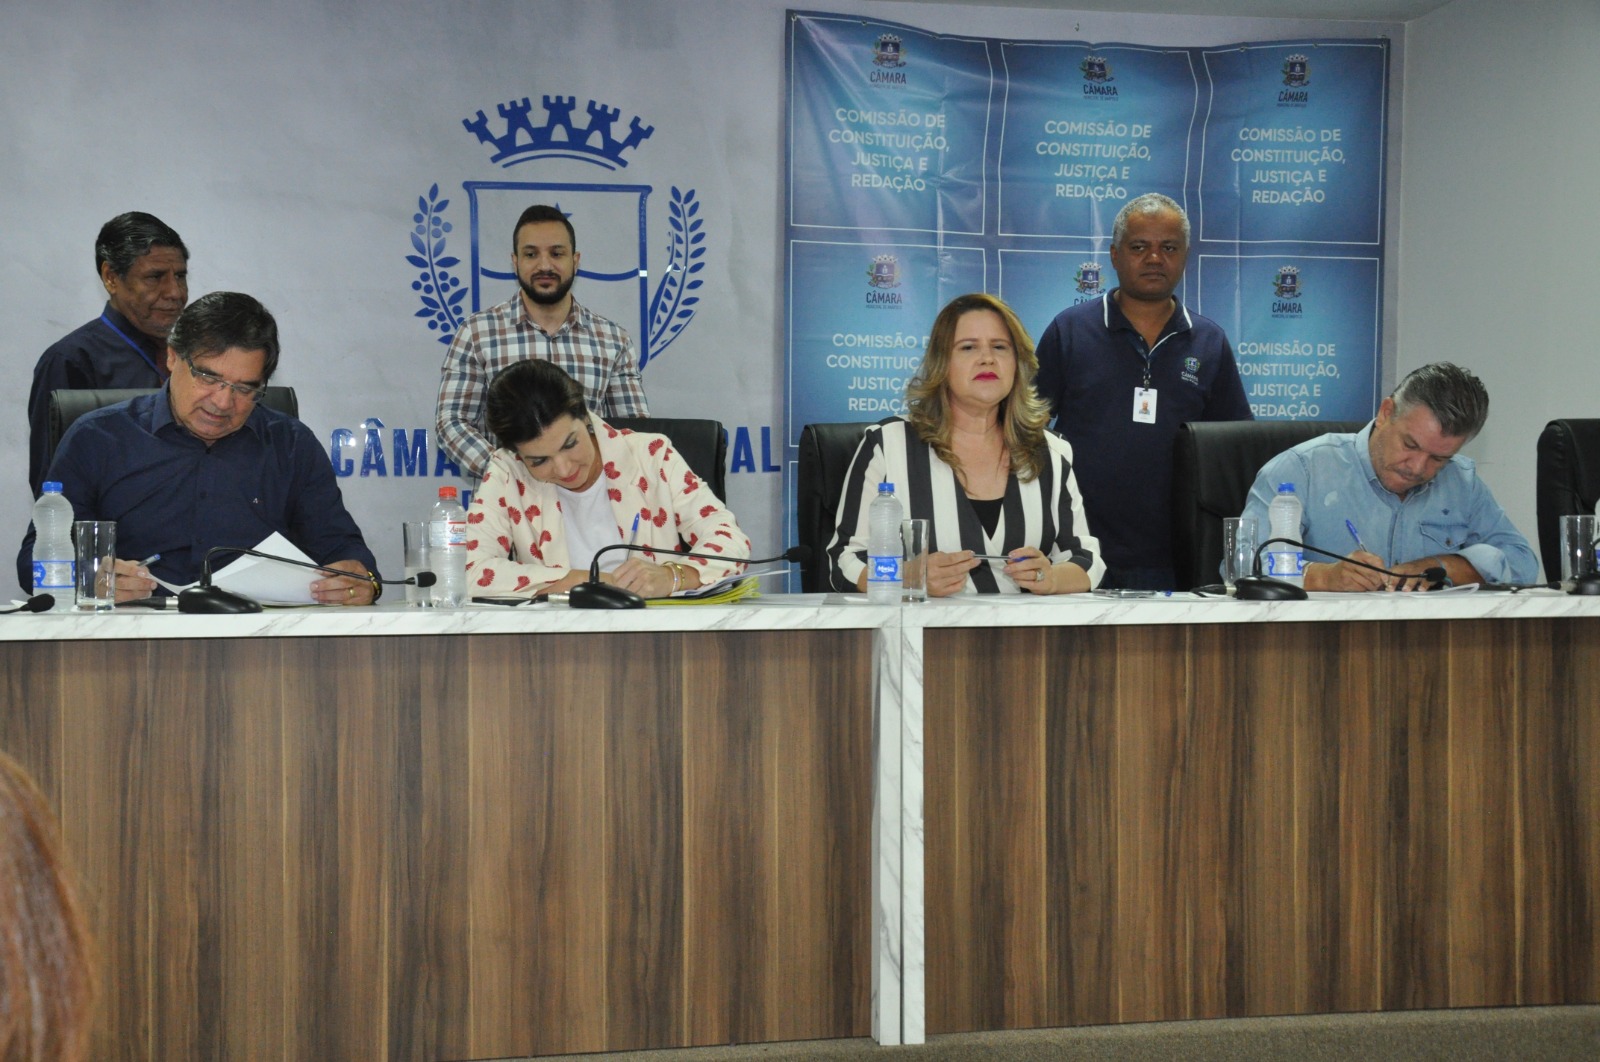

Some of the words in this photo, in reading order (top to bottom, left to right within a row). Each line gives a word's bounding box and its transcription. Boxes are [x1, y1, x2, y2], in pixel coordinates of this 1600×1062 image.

[870, 69, 906, 84] CÂMARA
[1083, 82, 1118, 96] CÂMARA
[1278, 88, 1308, 103] CÂMARA
[836, 108, 920, 126] COMISSÃO
[925, 114, 945, 128] DE
[1044, 120, 1127, 137] COMISSÃO
[1131, 124, 1152, 138] DE
[1239, 126, 1316, 142] COMISSÃO
[1320, 128, 1341, 142] DE
[829, 129, 950, 152] CONSTITUIÇÃO,
[1036, 141, 1151, 161] CONSTITUIÇÃO,
[1231, 146, 1346, 165] CONSTITUIÇÃO,
[851, 152, 914, 172] JUSTIÇA
[919, 157, 928, 171] E
[1054, 164, 1117, 182] JUSTIÇA
[1121, 166, 1130, 180] E
[1251, 169, 1313, 186] JUSTIÇA
[1318, 169, 1327, 182] E
[851, 173, 926, 192] REDAÇÃO
[1055, 183, 1127, 202] REDAÇÃO
[1252, 187, 1325, 206] REDAÇÃO
[866, 290, 903, 304] CÂMARA
[1272, 300, 1303, 313] CÂMARA
[832, 332, 918, 348] COMISSÃO
[1238, 340, 1313, 356] COMISSÃO
[1317, 343, 1335, 356] DE
[826, 354, 921, 373] CONSTITUIÇ
[1249, 383, 1309, 400] JUSTIÇA
[1313, 383, 1321, 396] E
[330, 417, 463, 477] CÂMA
